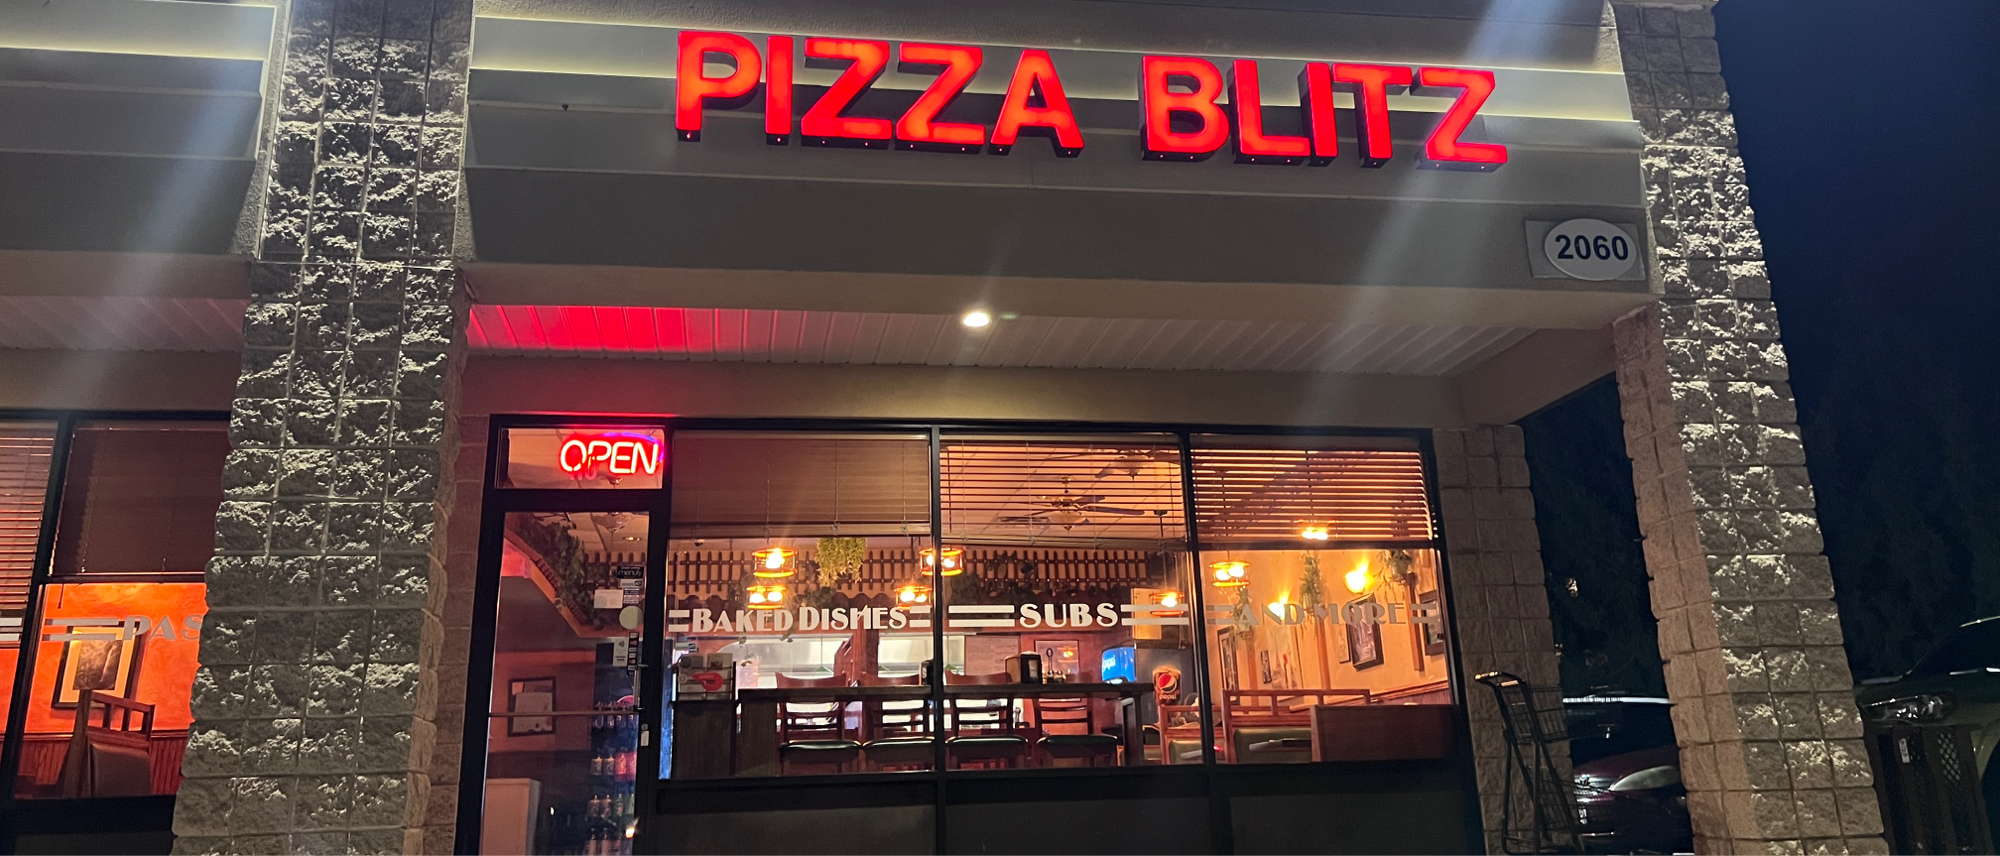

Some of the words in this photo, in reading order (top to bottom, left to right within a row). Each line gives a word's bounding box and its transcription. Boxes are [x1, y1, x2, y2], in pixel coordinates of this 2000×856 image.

[675, 30, 1085, 152] PIZZA
[1140, 54, 1508, 167] BLITZ
[1554, 234, 1629, 261] 2060
[560, 439, 659, 475] OPEN
[692, 606, 794, 633] BAKED
[799, 605, 907, 631] DISHES
[1019, 602, 1119, 628] SUBS
[1238, 602, 1306, 626] AND
[1314, 602, 1407, 625] MORE
